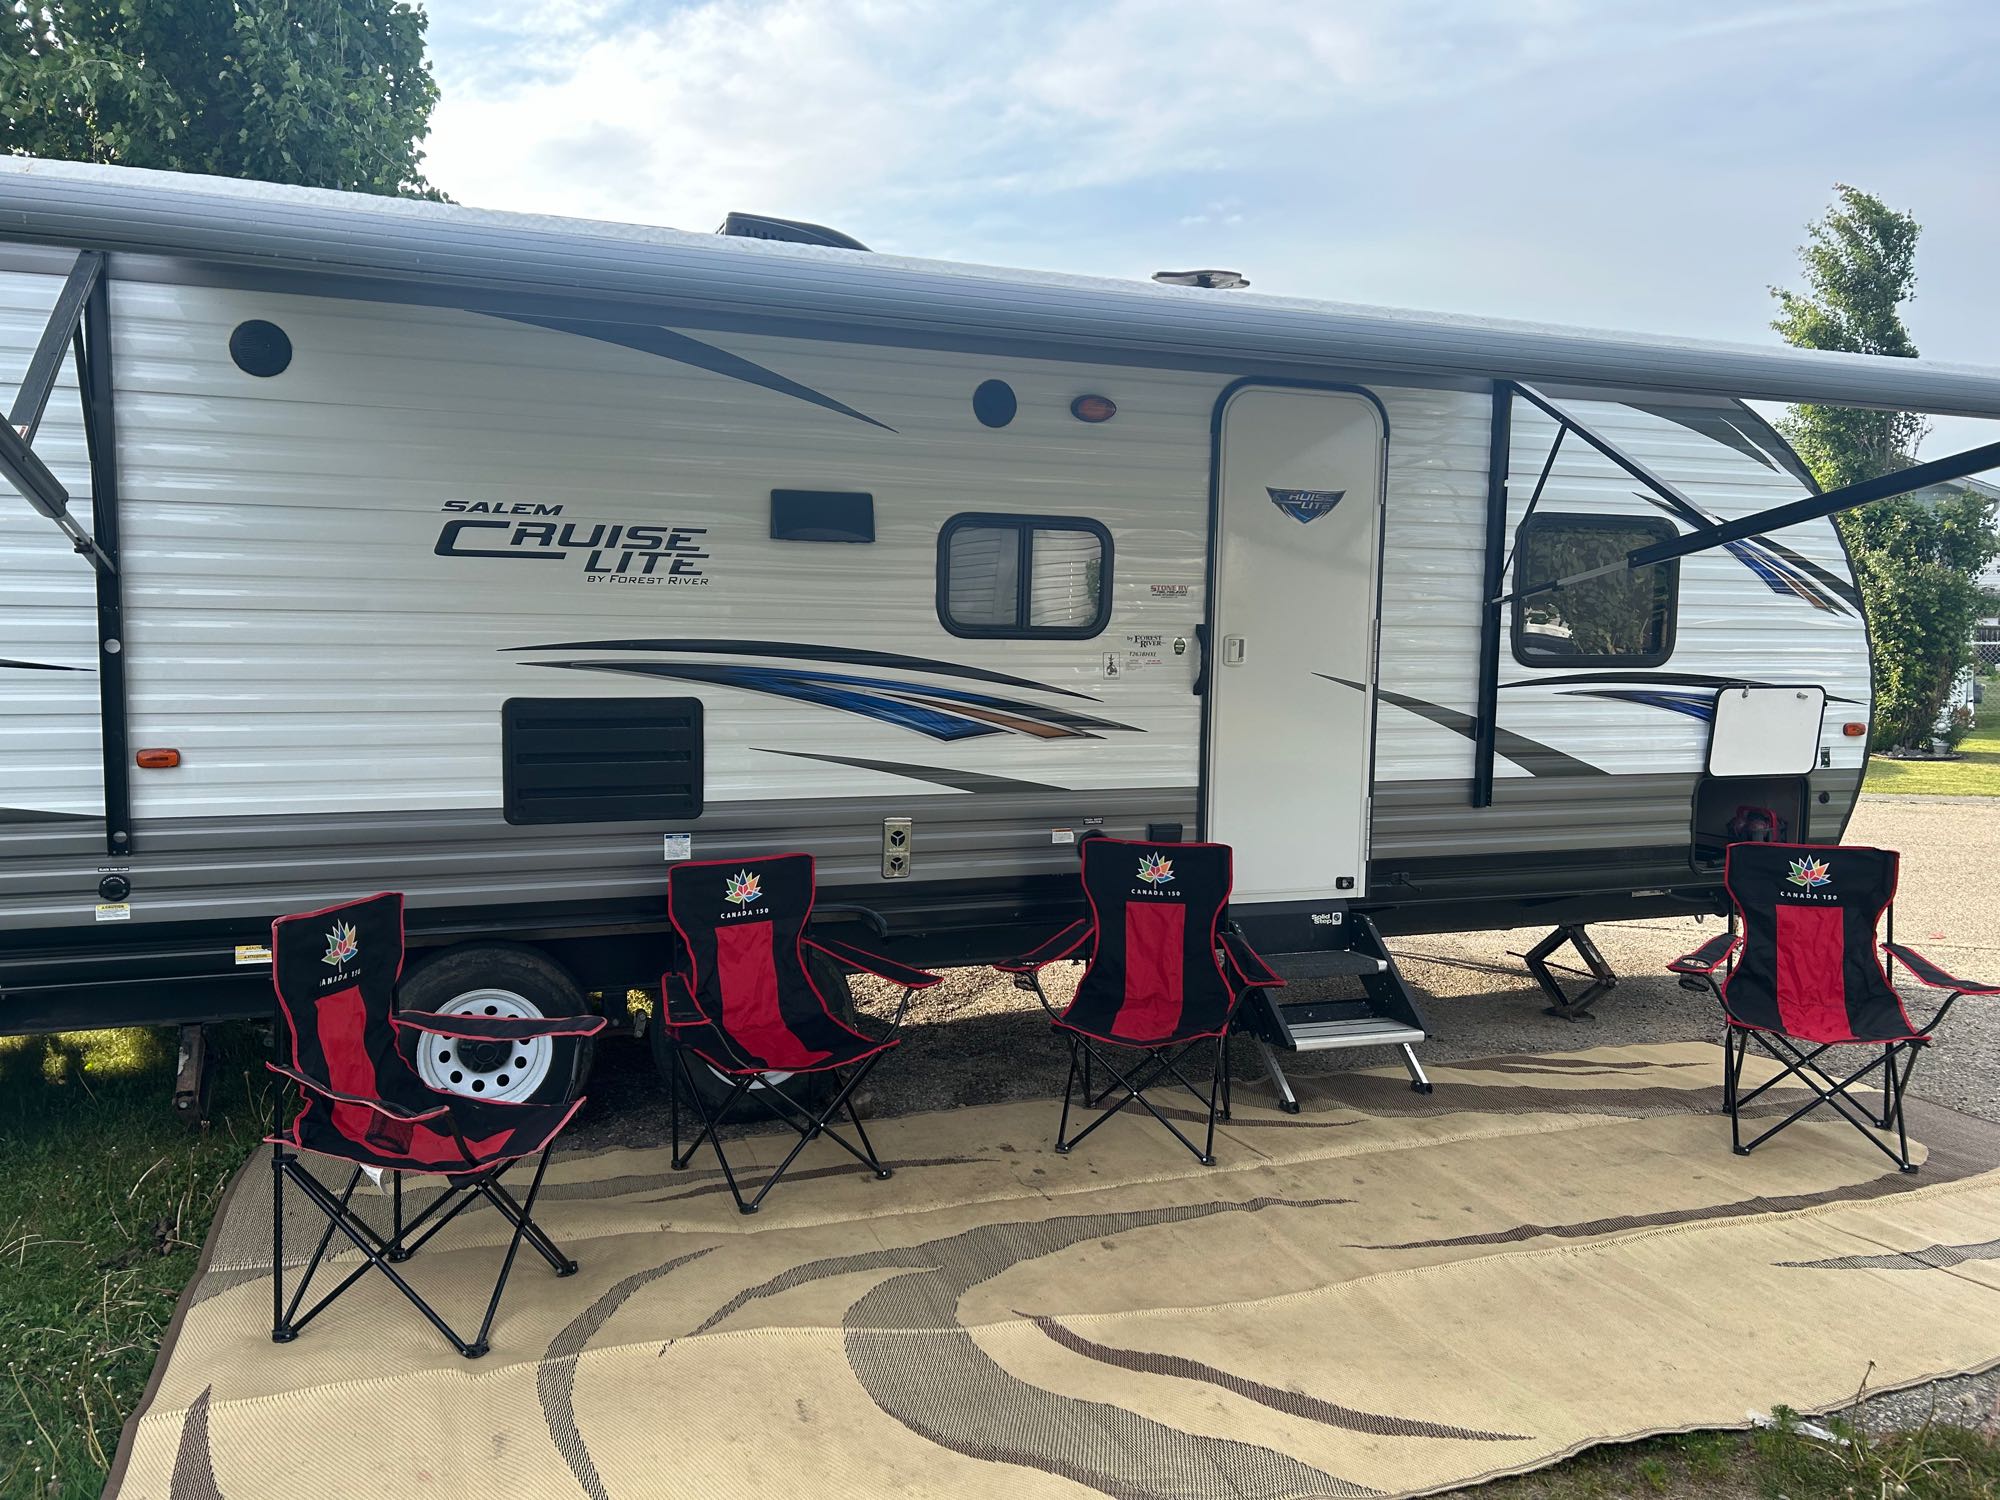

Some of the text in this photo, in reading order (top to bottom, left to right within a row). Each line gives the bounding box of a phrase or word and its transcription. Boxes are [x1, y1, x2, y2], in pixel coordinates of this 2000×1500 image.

[441, 500, 564, 516] SALEM
[434, 519, 708, 560] CRUISE
[584, 550, 710, 576] LITE
[587, 574, 709, 586] BY FOREST RIVER
[1134, 635, 1161, 643] FOREST
[1131, 888, 1164, 896] CANADA
[1780, 891, 1818, 900] CANADA
[720, 907, 769, 919] CANADA 150
